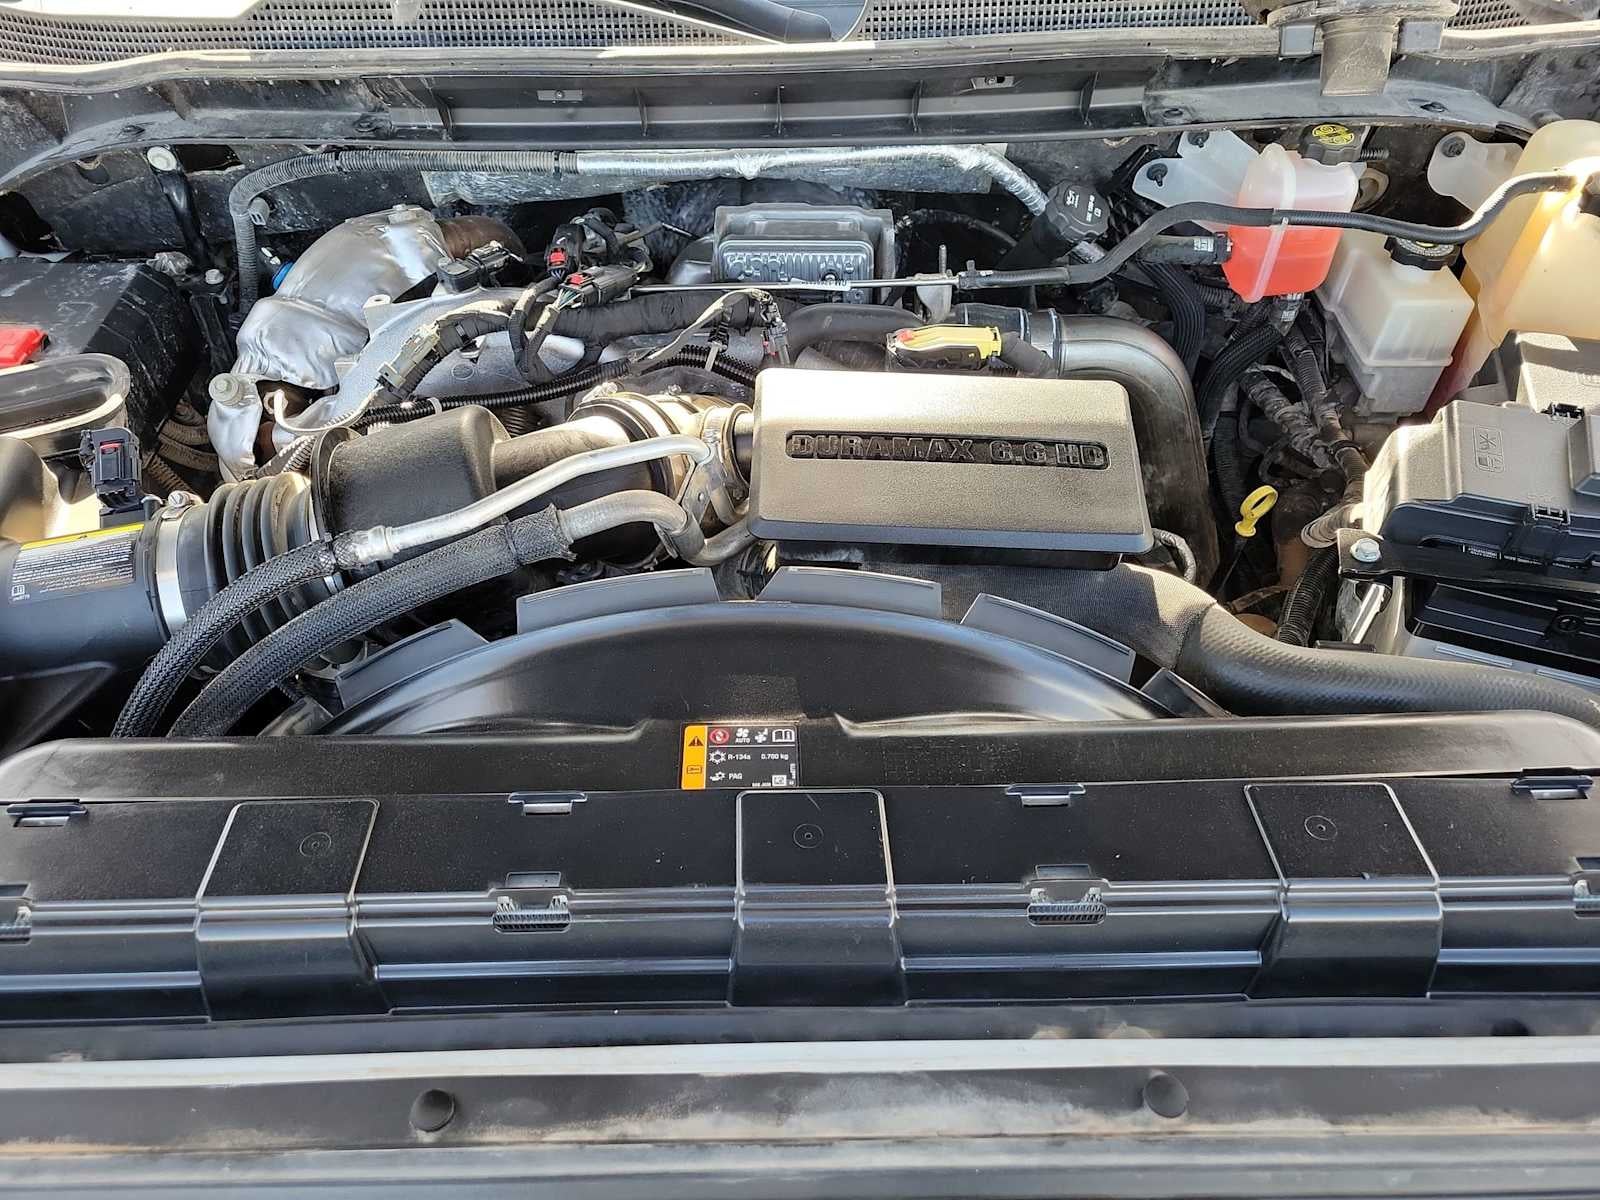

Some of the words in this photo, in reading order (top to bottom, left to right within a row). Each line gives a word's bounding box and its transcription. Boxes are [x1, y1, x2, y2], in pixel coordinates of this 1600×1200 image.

[791, 434, 975, 462] DURAMAX
[989, 440, 1047, 464] 6.6
[1055, 443, 1105, 466] HD
[728, 772, 743, 780] PAG
